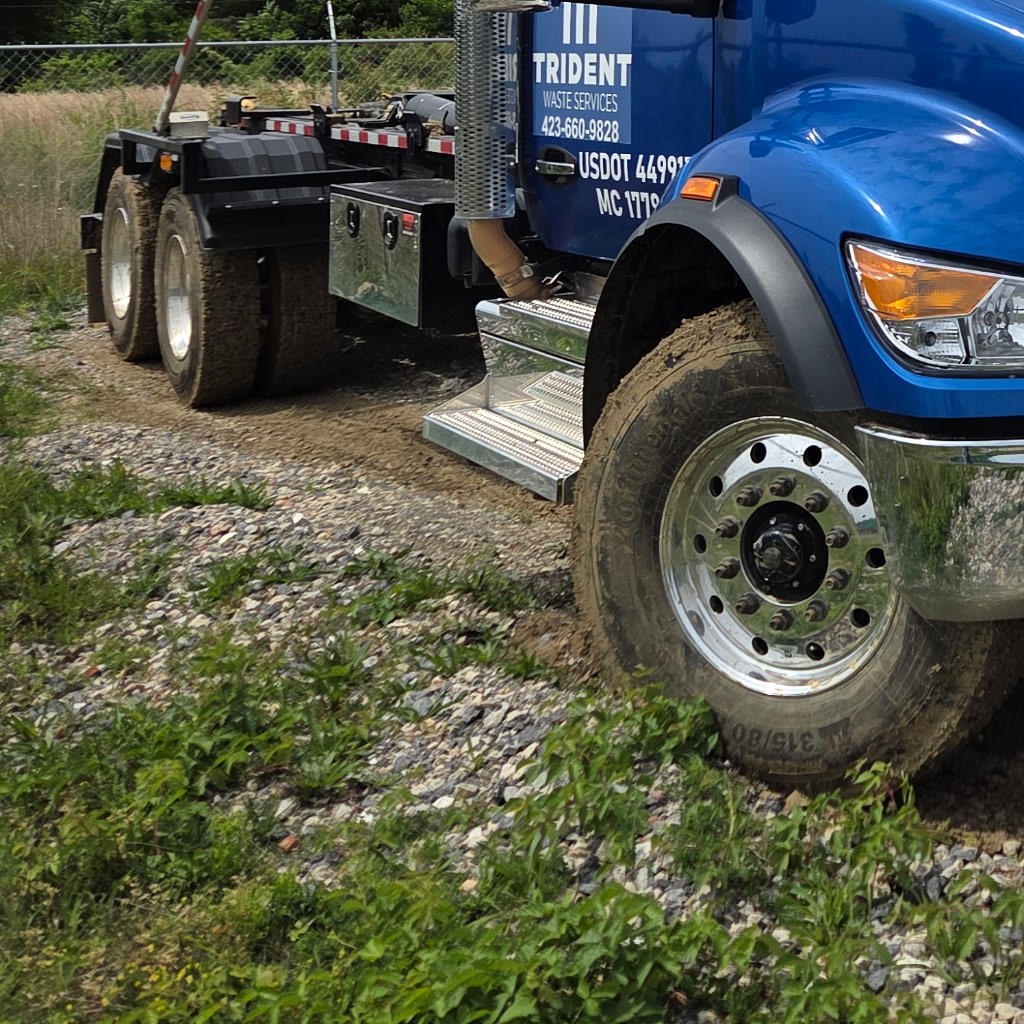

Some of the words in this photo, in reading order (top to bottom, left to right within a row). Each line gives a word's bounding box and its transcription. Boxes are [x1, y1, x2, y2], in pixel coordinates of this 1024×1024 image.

[533, 53, 632, 87] TRIDENT
[543, 90, 573, 110] WASTE
[573, 91, 618, 112] SERVICES
[541, 115, 620, 143] 423-660-9828
[579, 151, 632, 182] USDOT
[596, 187, 623, 217] MC
[731, 723, 815, 753] 315/80
